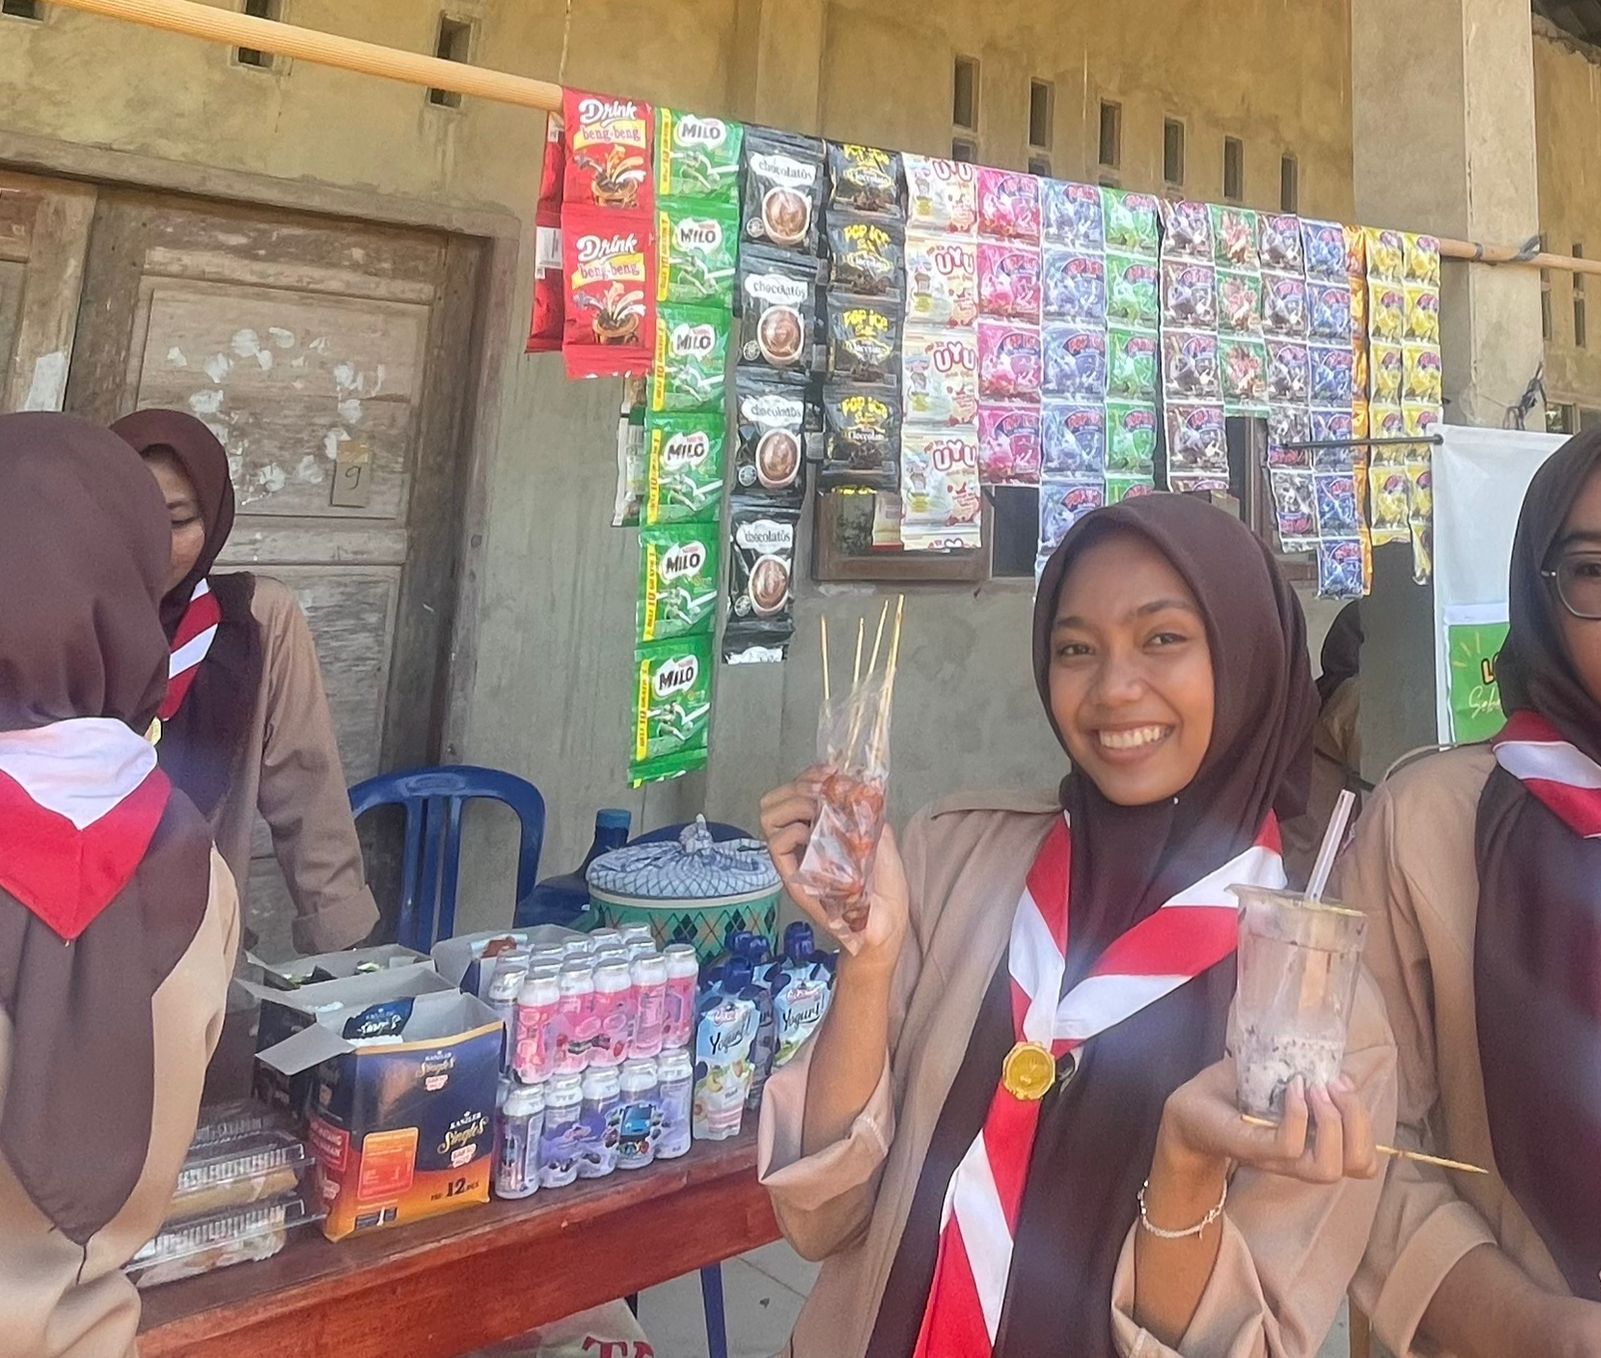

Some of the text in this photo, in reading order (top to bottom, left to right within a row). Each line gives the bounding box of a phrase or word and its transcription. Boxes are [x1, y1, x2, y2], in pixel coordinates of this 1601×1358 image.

[578, 98, 638, 127] Drink
[582, 126, 641, 142] beng-beng
[682, 122, 721, 140] MILO
[680, 229, 716, 245] MILO
[843, 224, 867, 243] POP
[576, 233, 637, 262] Drink
[935, 246, 974, 275] UYU
[579, 262, 640, 280] beng-beng
[843, 308, 866, 326] POP
[676, 334, 711, 350] MILO
[933, 341, 976, 373] UYU
[842, 396, 865, 417] POP
[668, 442, 705, 461] MILO
[933, 439, 976, 471] UYU
[345, 465, 361, 491] 9
[666, 553, 701, 574] MILO
[648, 592, 656, 606] 10
[659, 666, 694, 690] MILO
[783, 1002, 820, 1031] Yogurt
[446, 1177, 466, 1197] 12
